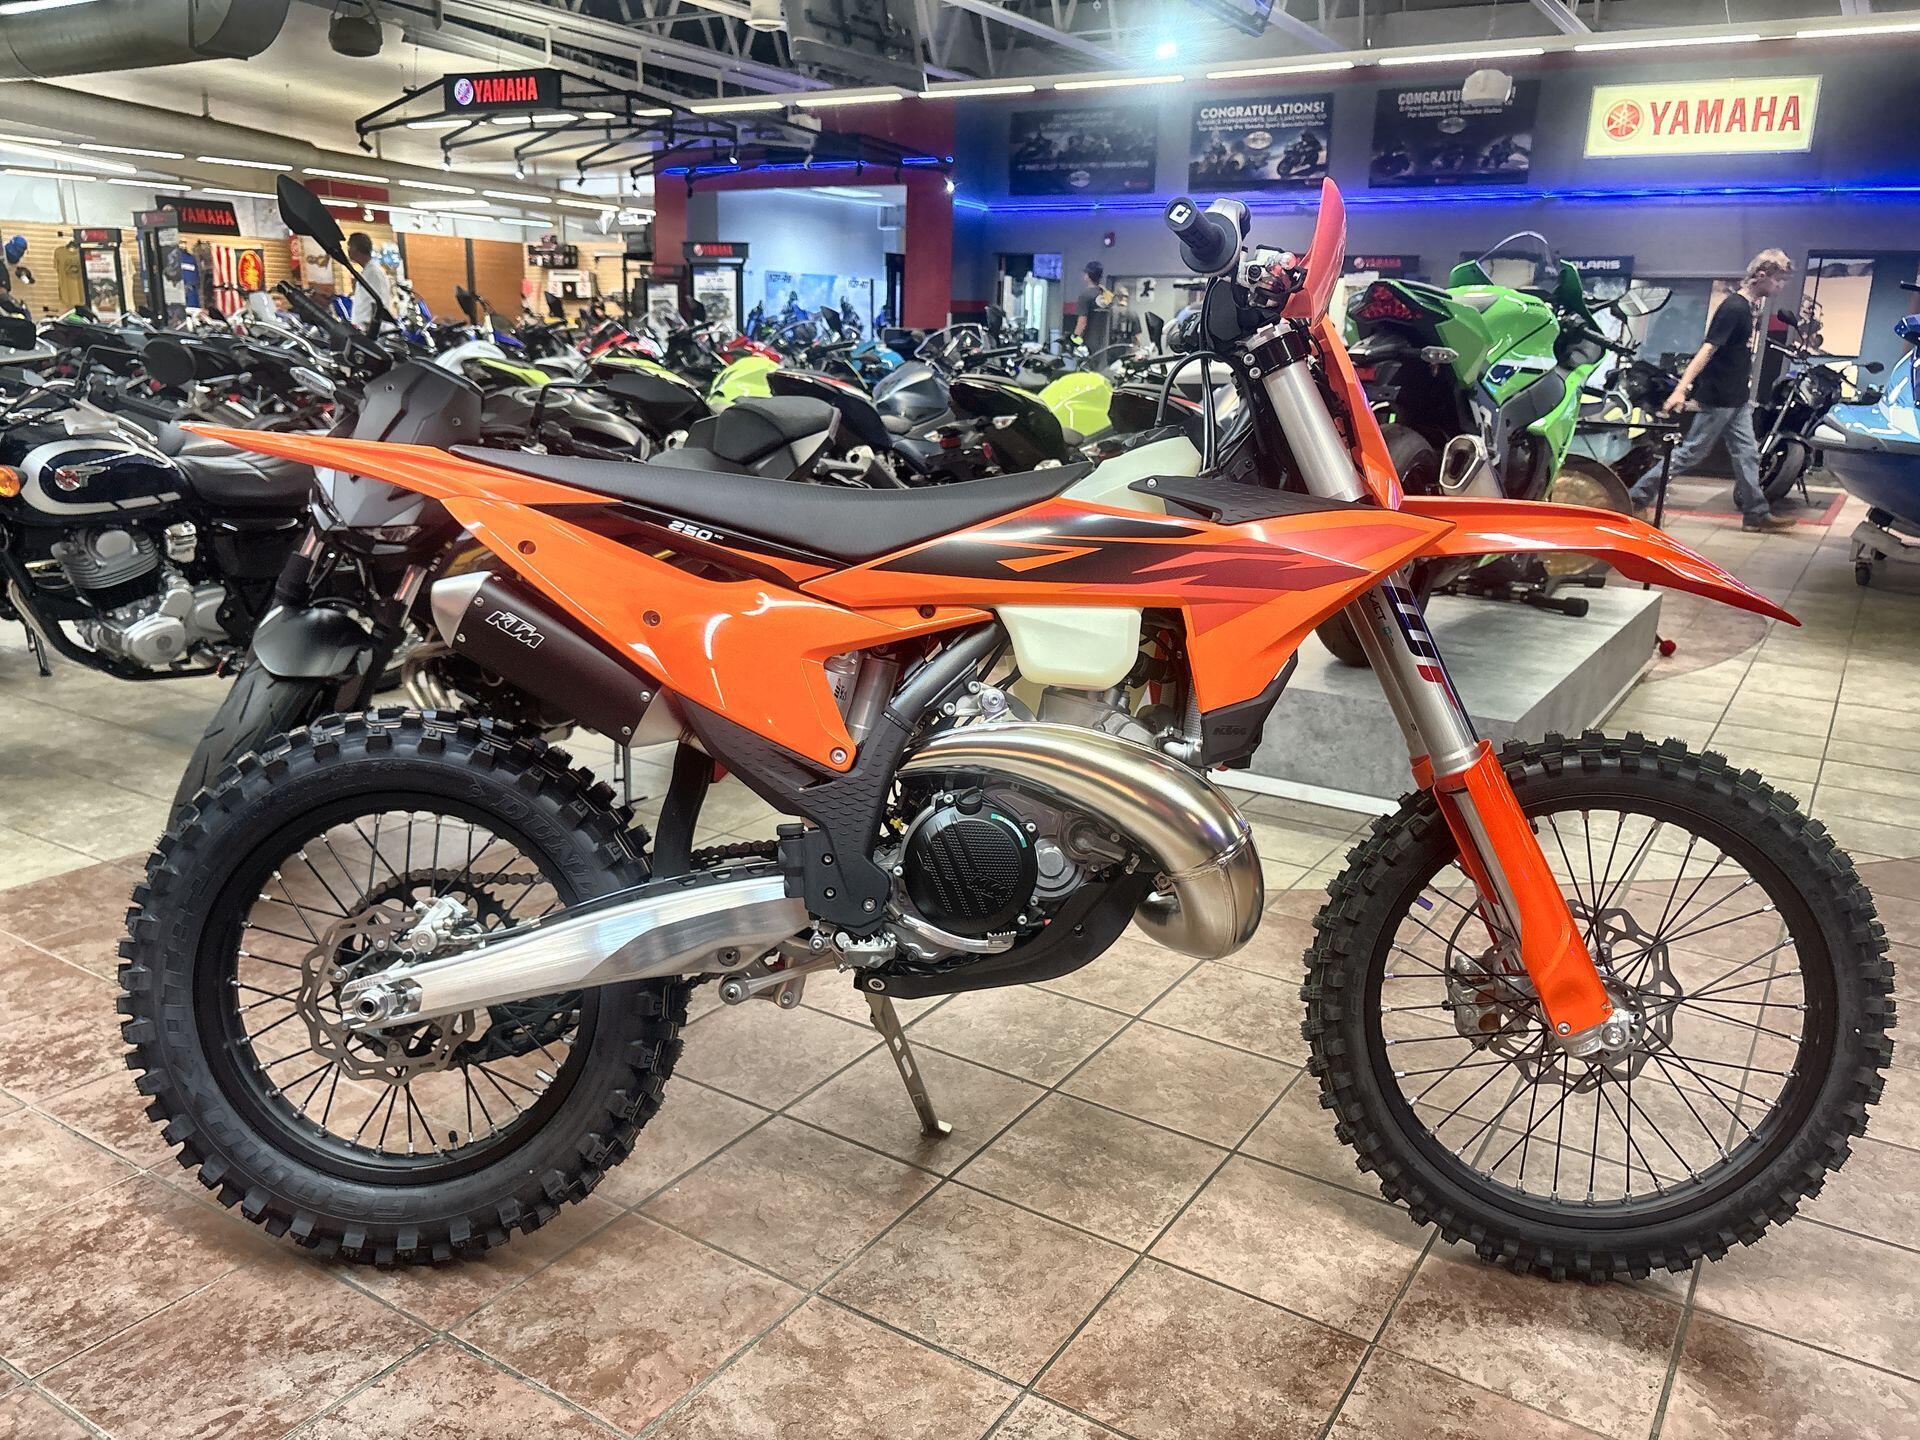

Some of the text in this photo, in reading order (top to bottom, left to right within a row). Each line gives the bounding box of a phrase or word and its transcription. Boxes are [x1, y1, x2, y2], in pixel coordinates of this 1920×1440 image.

[473, 76, 538, 103] YAMAHA
[1200, 101, 1325, 119] CONGRATULATIONS!
[1650, 96, 1800, 135] YAMAHA
[180, 206, 235, 226] YAMAHA
[668, 520, 713, 541] 250
[485, 610, 545, 650] KTM
[488, 793, 593, 896] DUNL
